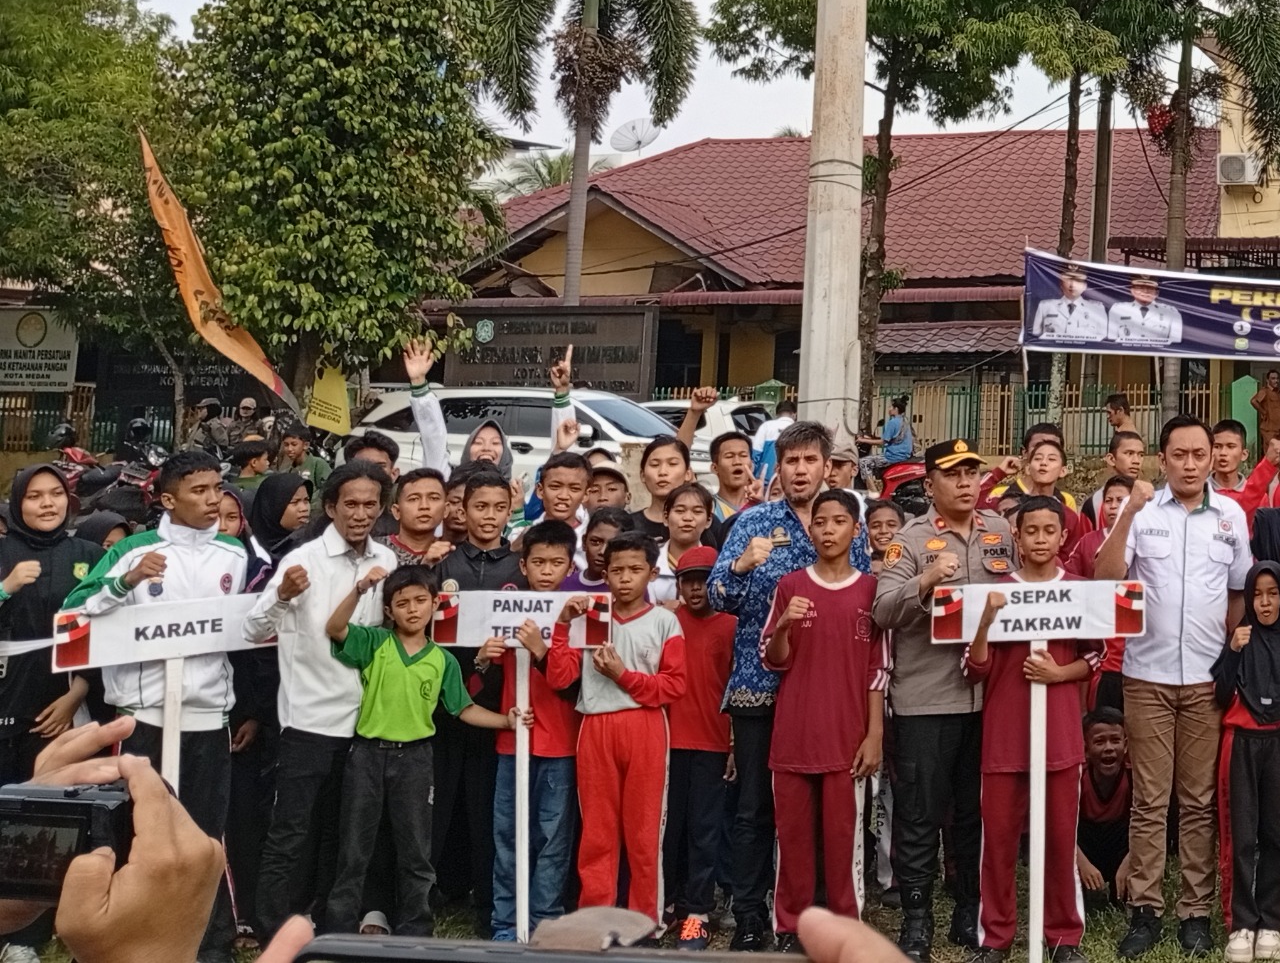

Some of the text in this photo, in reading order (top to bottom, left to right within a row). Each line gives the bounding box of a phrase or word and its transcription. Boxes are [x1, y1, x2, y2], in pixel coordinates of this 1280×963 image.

[1010, 588, 1073, 605] SEPAK
[492, 599, 554, 614] PANJAT
[134, 617, 224, 642] KARATE
[491, 625, 552, 641] TEBG
[1000, 616, 1083, 633] TAKRAW
